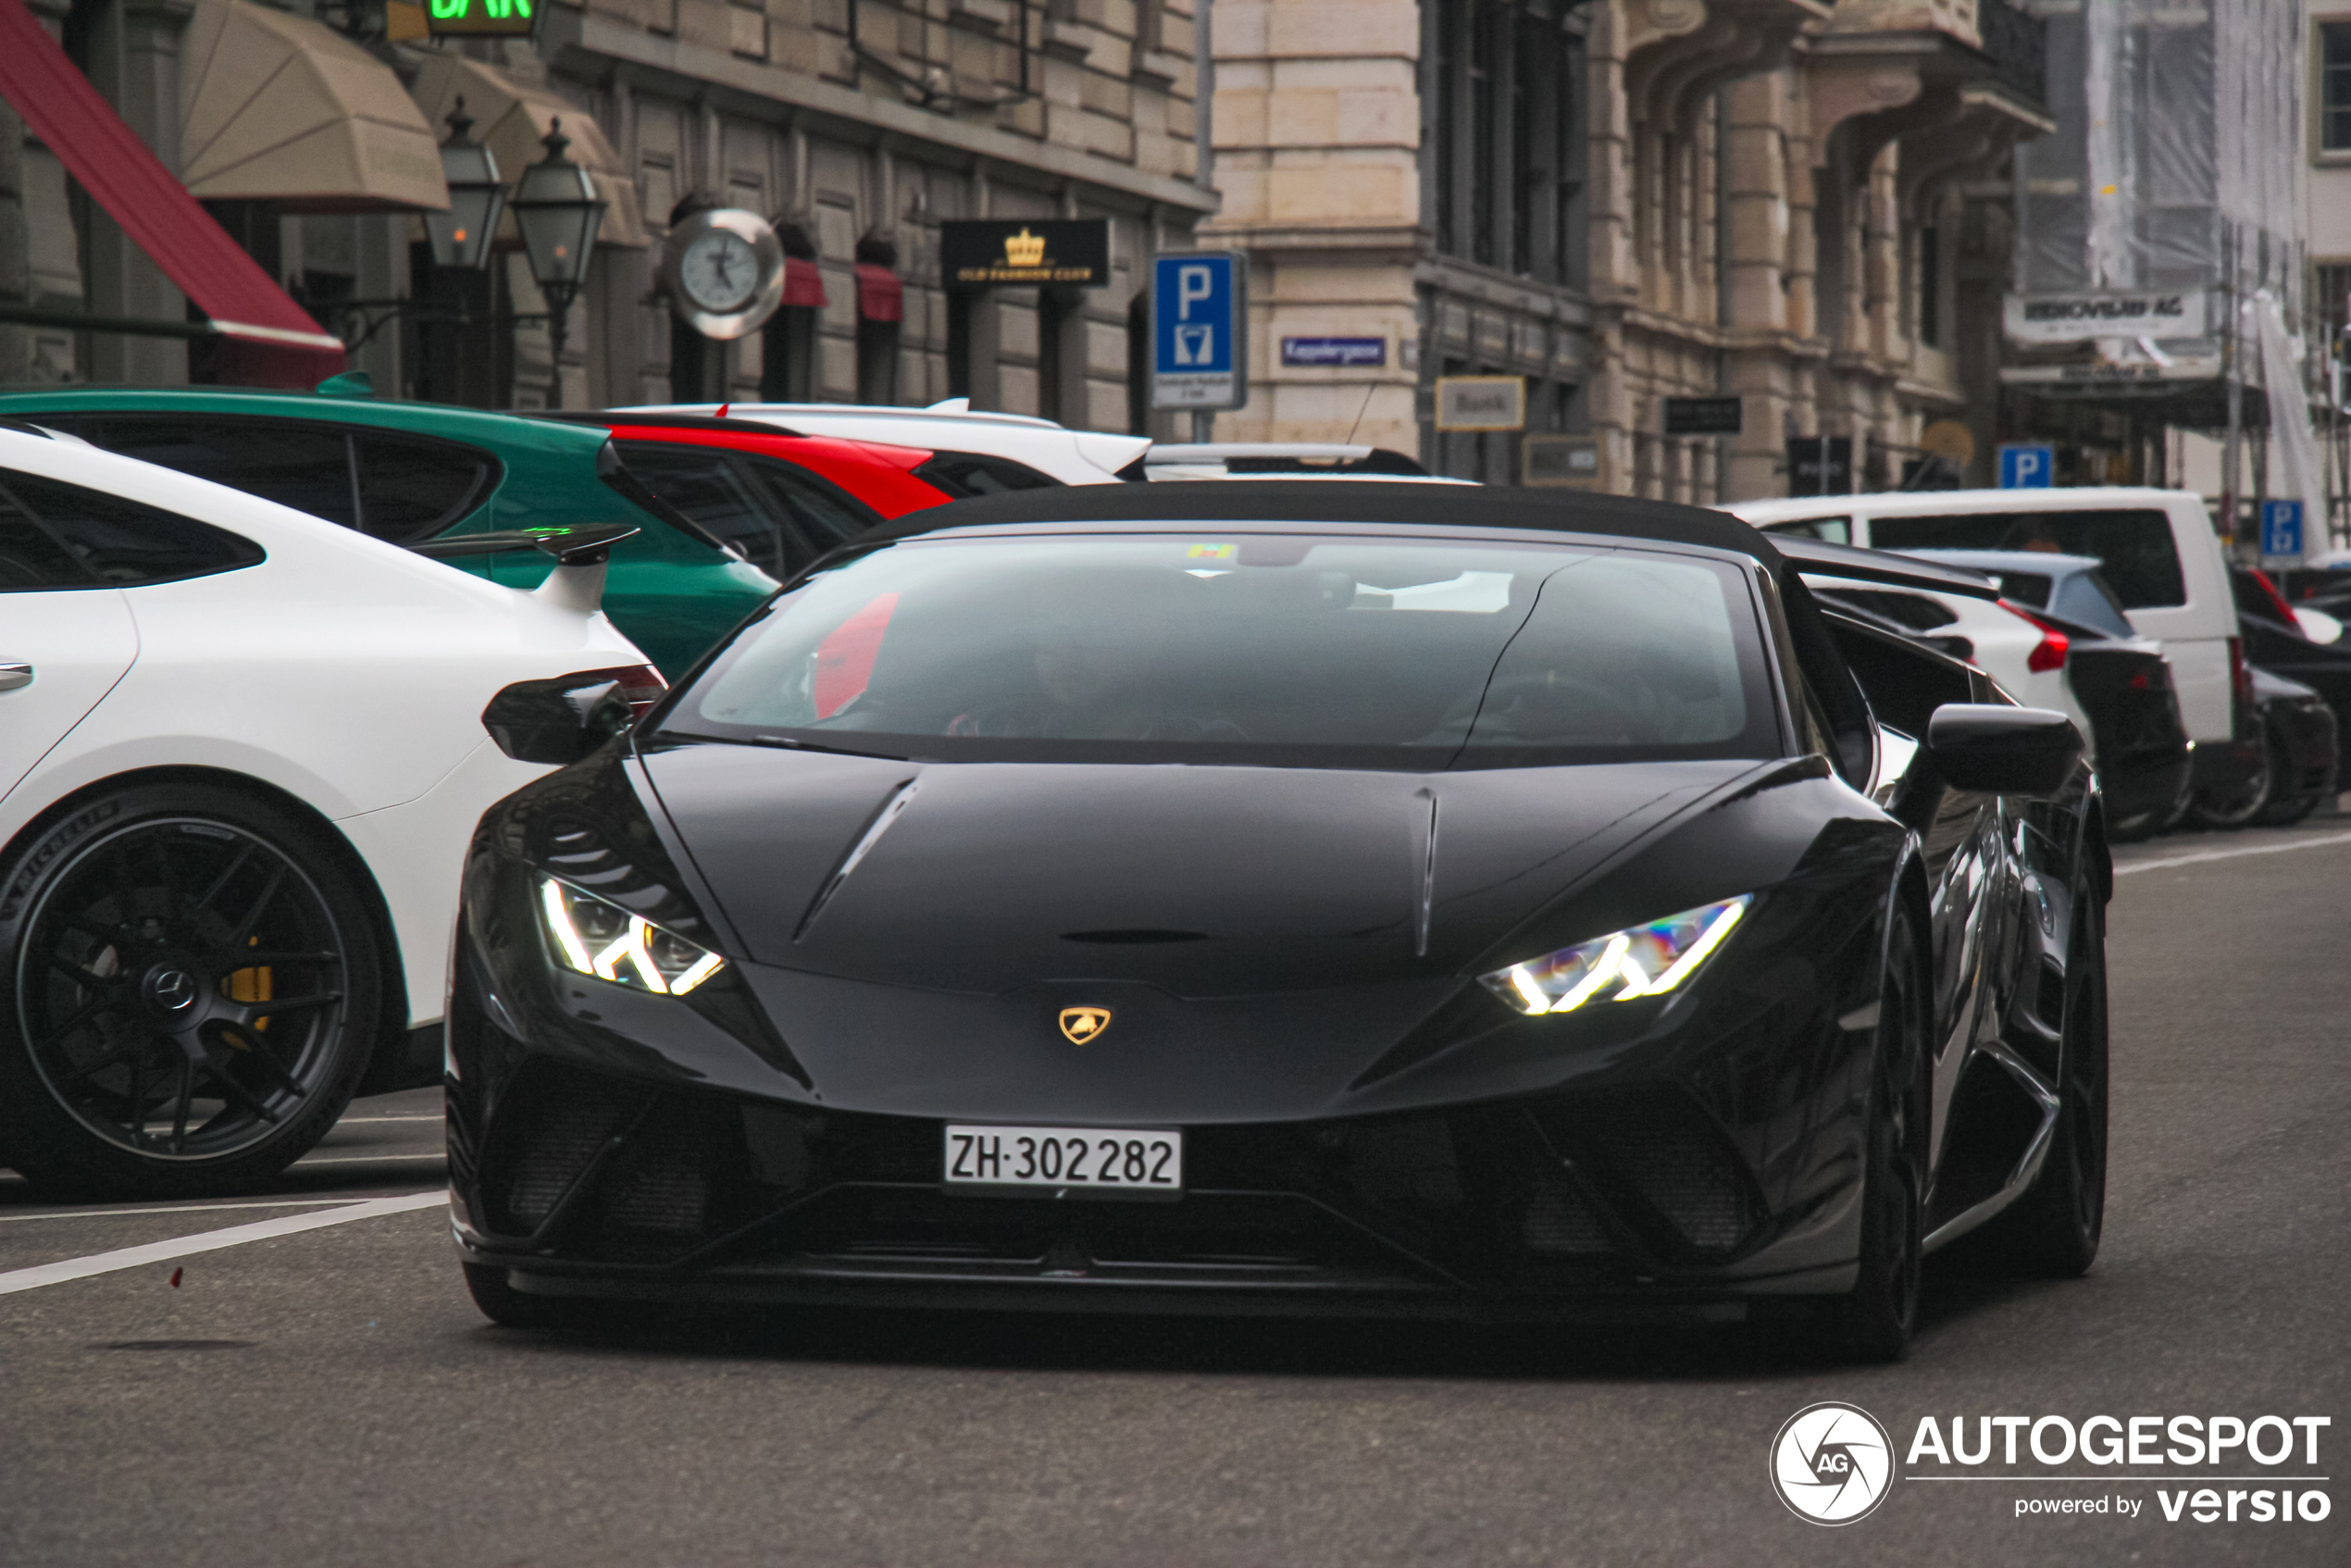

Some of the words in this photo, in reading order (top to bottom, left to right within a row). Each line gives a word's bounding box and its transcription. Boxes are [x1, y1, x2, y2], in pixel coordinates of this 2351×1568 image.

[1178, 265, 1213, 320] P
[2015, 454, 2038, 488] P
[2273, 506, 2292, 529] P
[16, 801, 118, 890] MICHELIN
